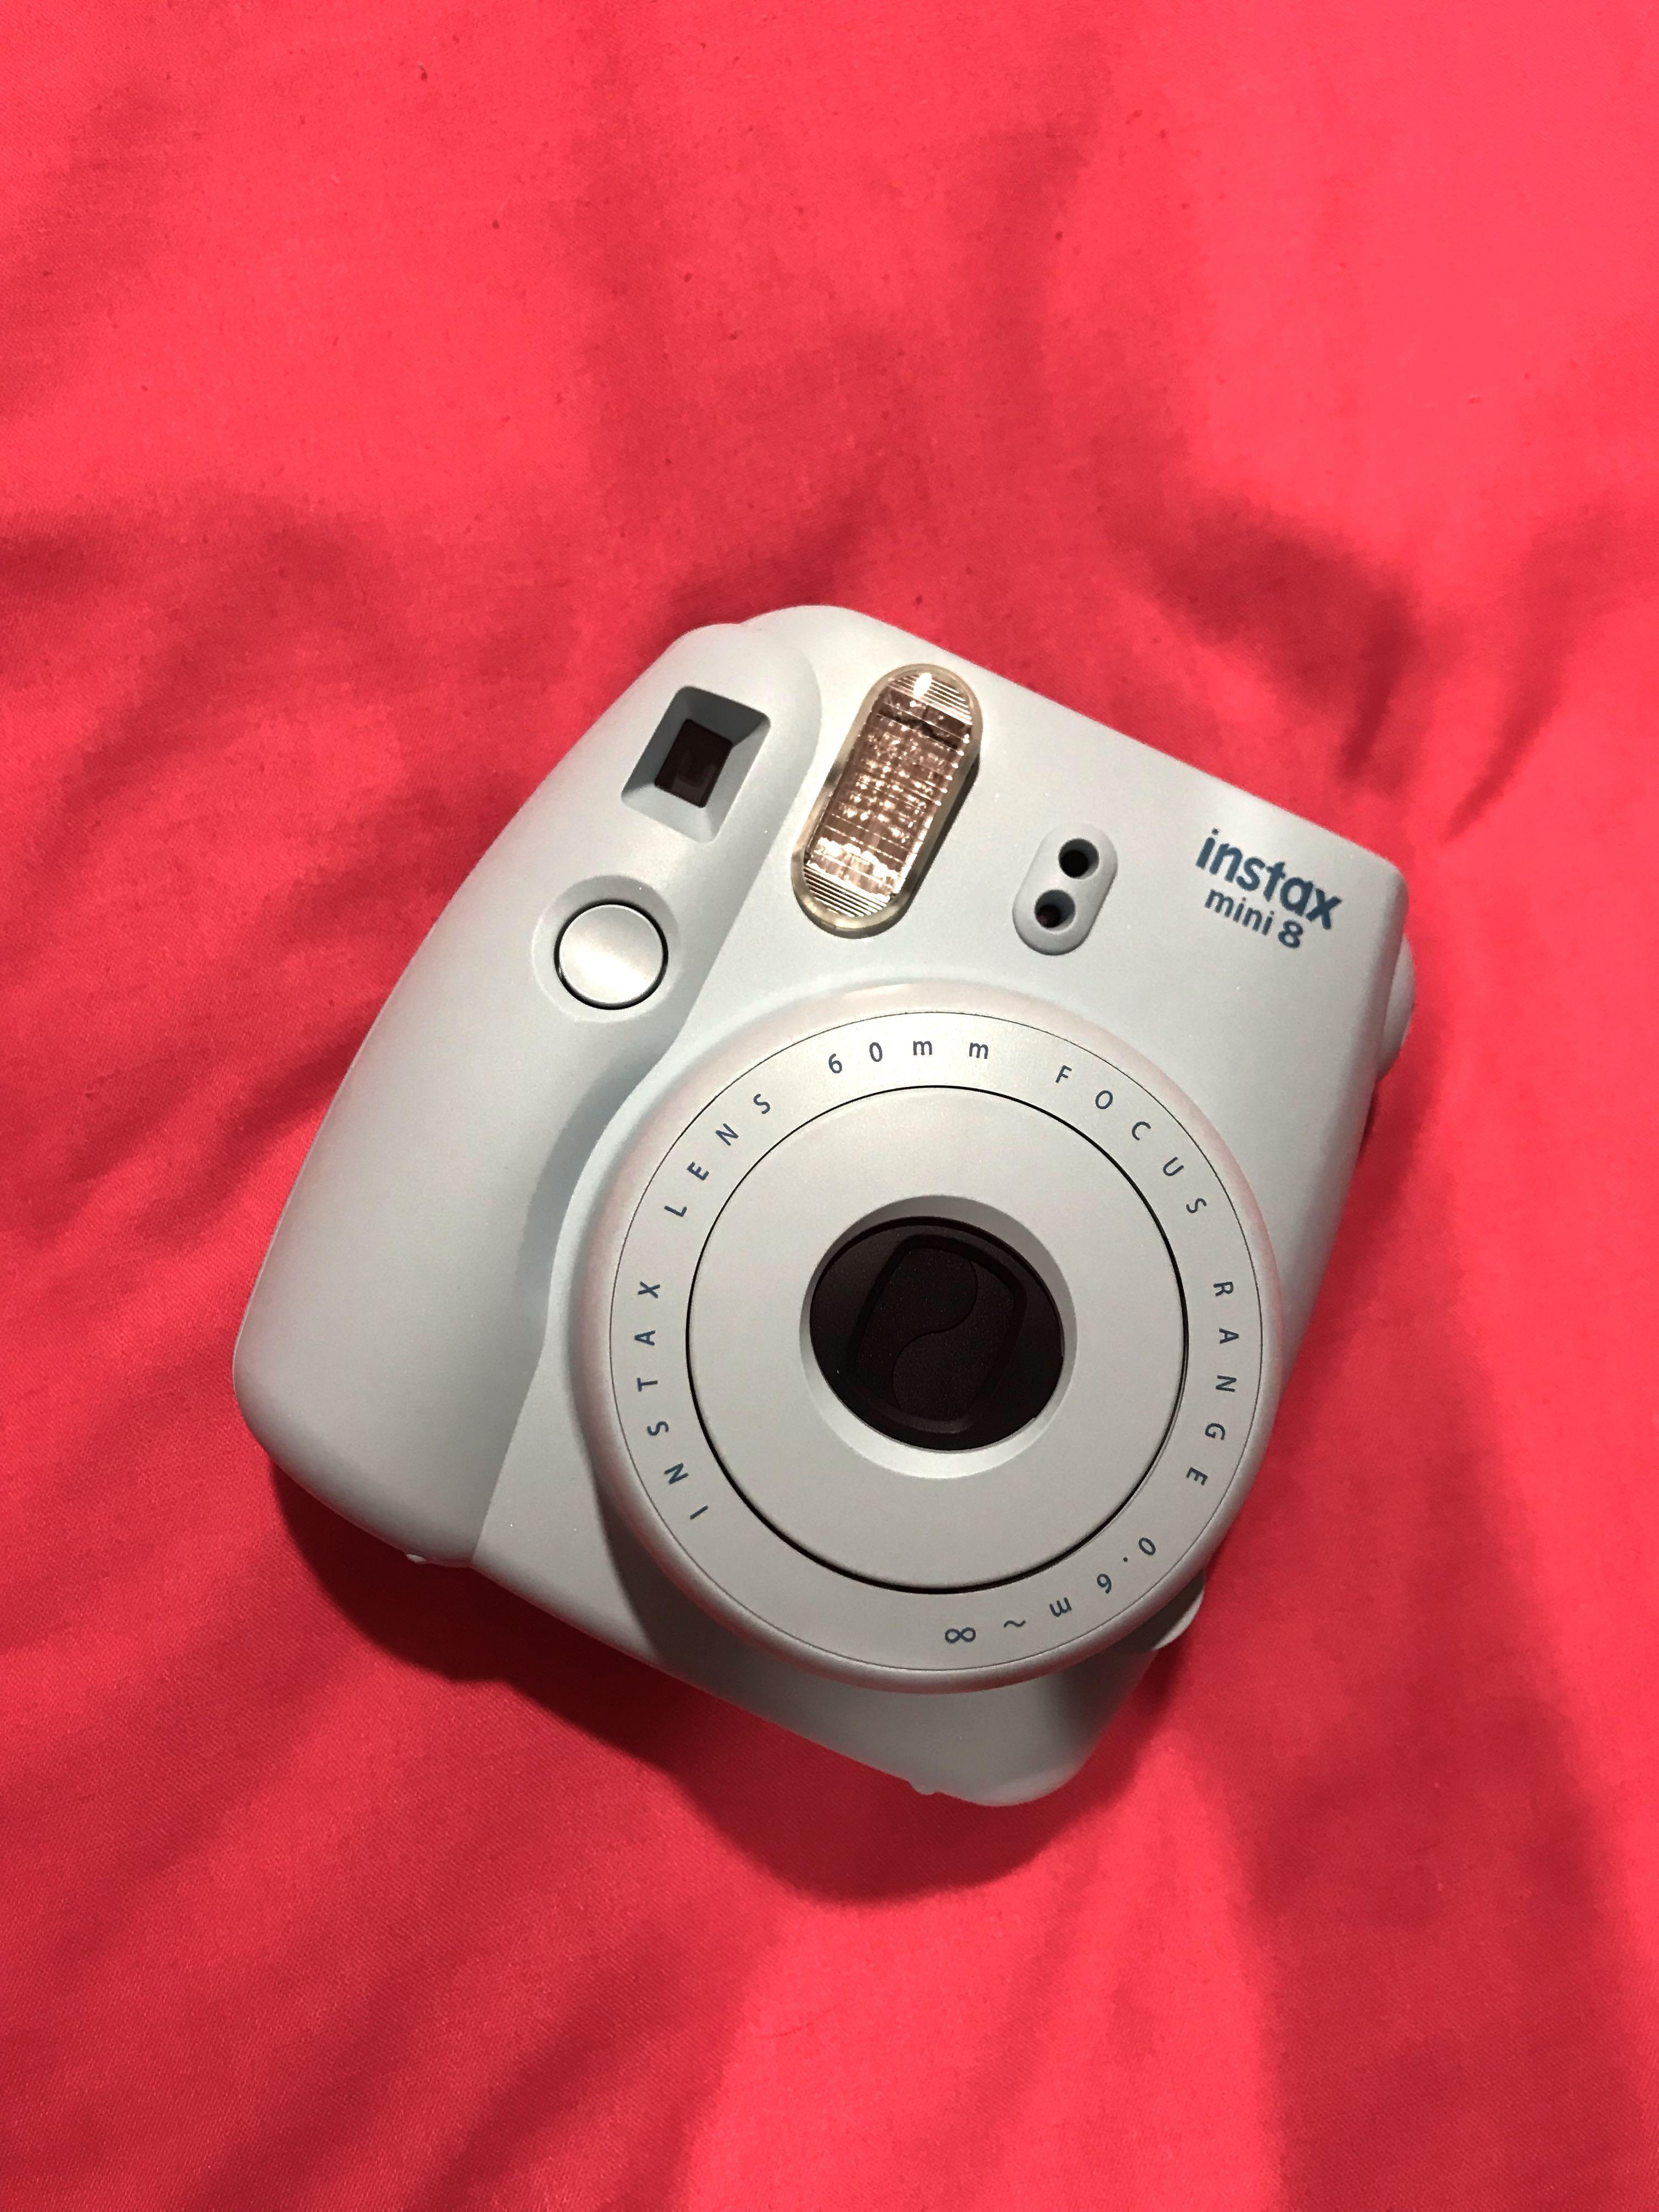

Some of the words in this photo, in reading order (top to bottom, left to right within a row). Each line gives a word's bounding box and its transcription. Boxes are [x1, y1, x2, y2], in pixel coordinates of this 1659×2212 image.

[1195, 828, 1342, 930] instax
[1205, 889, 1274, 935] mini
[1278, 919, 1303, 949] 8
[829, 1040, 989, 1073] 60mm
[664, 1094, 770, 1217] LENS
[1056, 1065, 1206, 1214] FOCUS
[634, 1282, 708, 1520] INSTAX
[1186, 1281, 1239, 1485] RANGE
